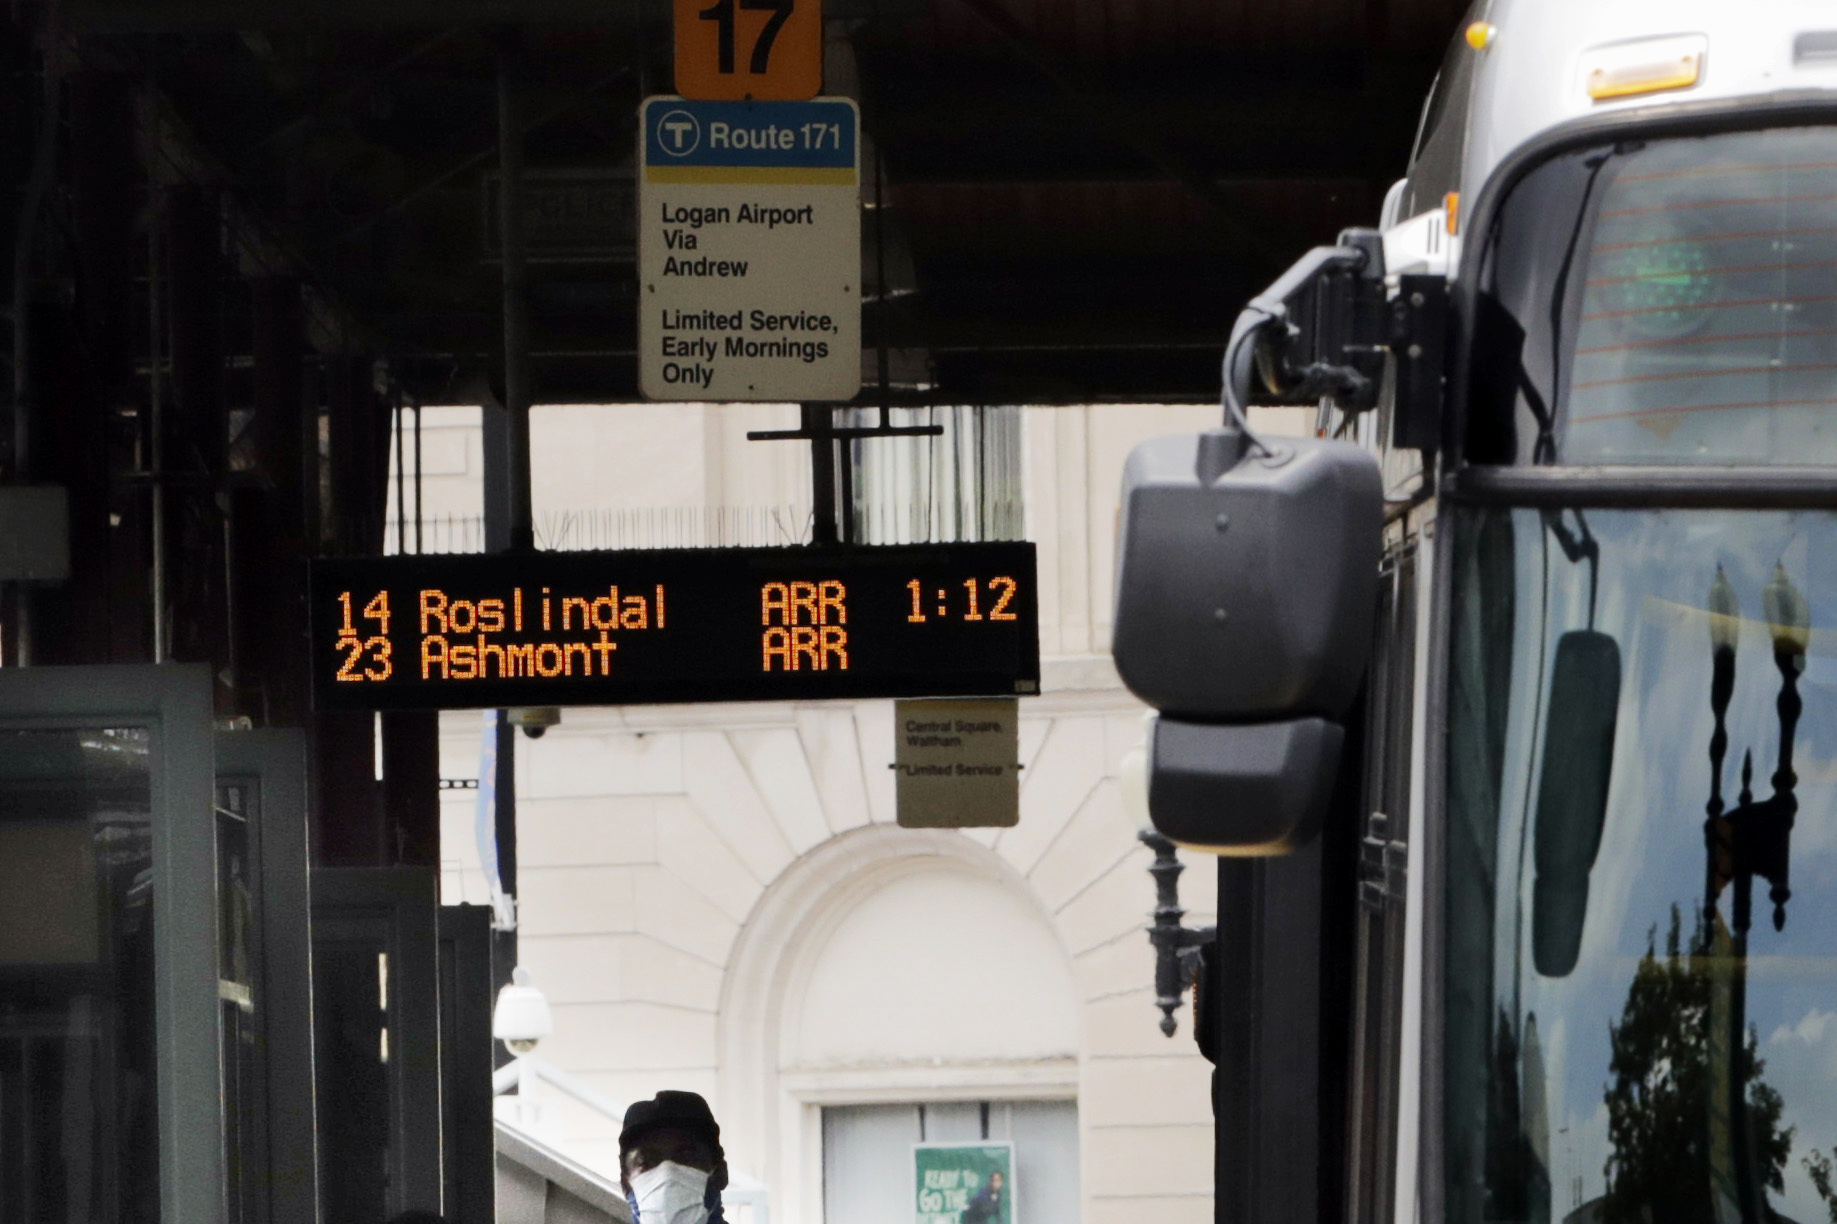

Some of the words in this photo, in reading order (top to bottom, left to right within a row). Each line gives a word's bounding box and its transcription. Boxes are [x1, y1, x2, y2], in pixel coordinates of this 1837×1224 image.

[698, 0, 794, 74] 17
[710, 122, 794, 150] Route
[800, 123, 840, 150] 171
[662, 203, 730, 228] Logan
[736, 204, 813, 229] Airport
[663, 230, 697, 250] Via
[663, 256, 748, 277] Andrew
[662, 309, 743, 330] Limited
[750, 310, 838, 334] Service,
[662, 337, 717, 362] Early
[725, 337, 829, 363] Mornings
[662, 363, 714, 389] Only
[336, 589, 392, 637] 14
[420, 584, 666, 634] Roslindal
[762, 580, 847, 627] ARR
[906, 576, 1018, 624] 1:12
[335, 638, 393, 682] 23
[420, 630, 617, 679] Ashmont
[762, 627, 848, 672] ARR
[906, 720, 952, 732] Central
[906, 764, 953, 776] Limited
